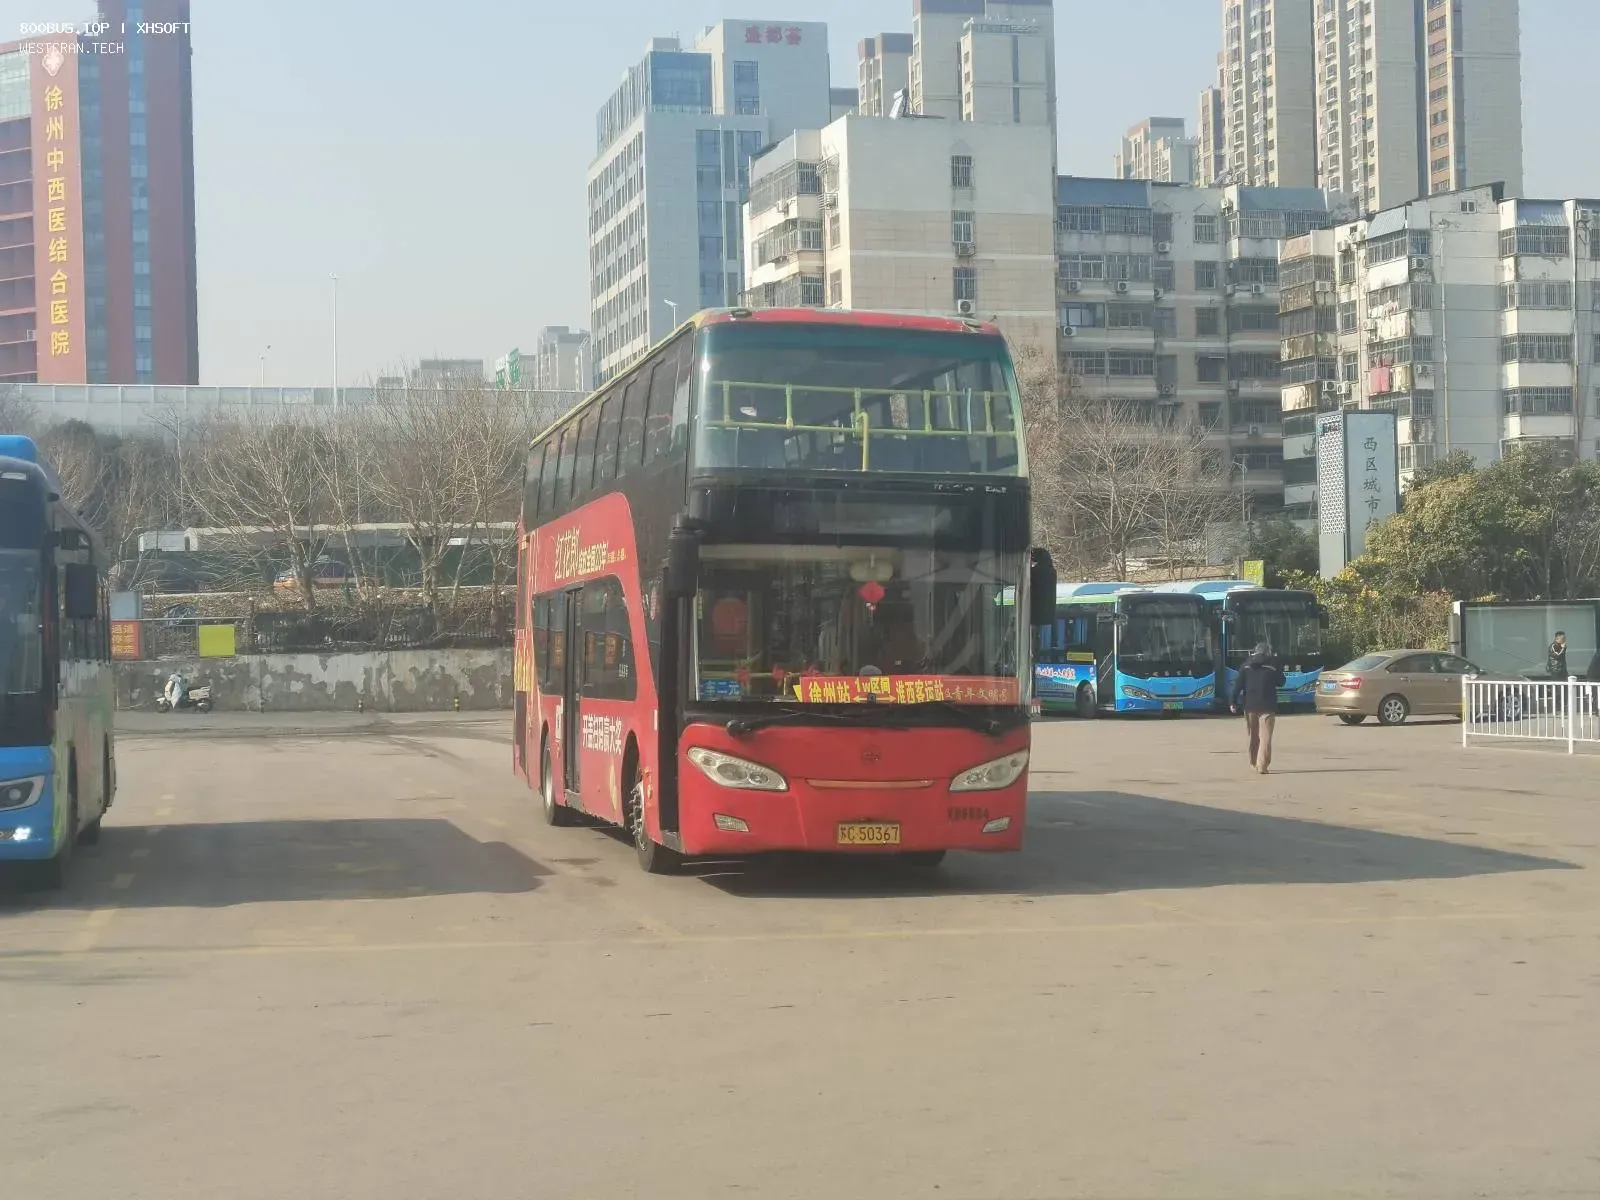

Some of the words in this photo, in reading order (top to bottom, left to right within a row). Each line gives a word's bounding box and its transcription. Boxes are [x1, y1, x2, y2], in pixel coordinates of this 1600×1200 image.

[44, 86, 70, 357] 徐州中西医结合医院
[808, 681, 850, 704] 徐州站
[896, 679, 944, 704] 淮西客运站
